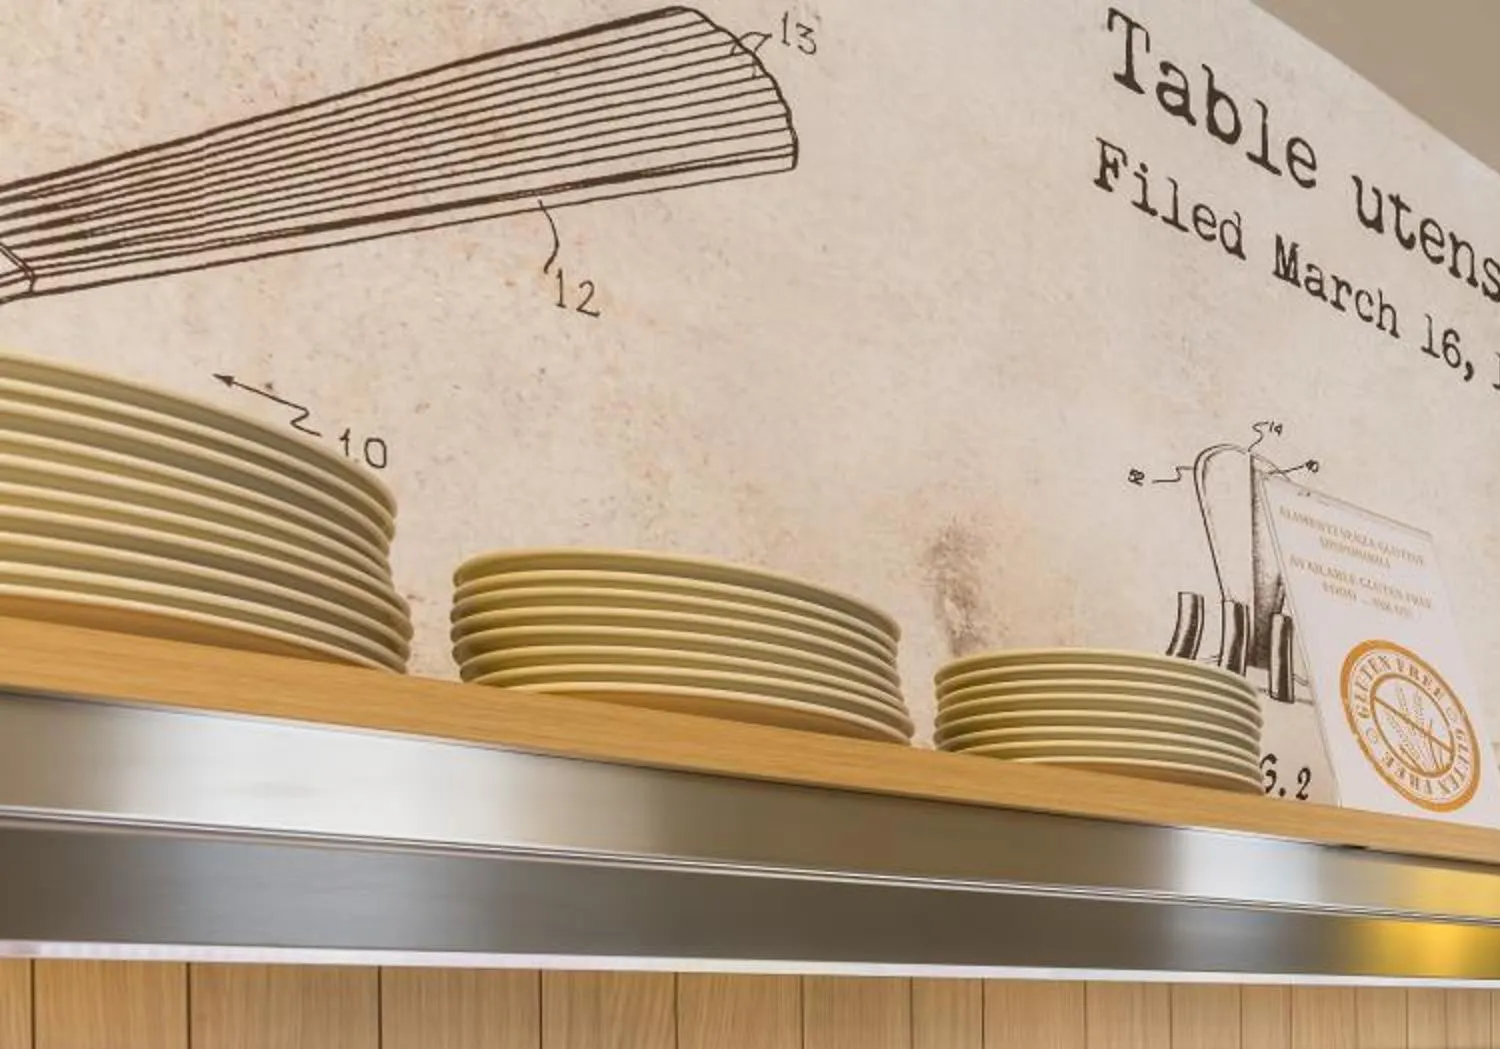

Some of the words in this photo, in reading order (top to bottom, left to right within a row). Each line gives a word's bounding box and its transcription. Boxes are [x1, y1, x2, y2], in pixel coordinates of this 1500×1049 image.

[781, 11, 817, 55] 13
[1106, 7, 1318, 190] Table
[1093, 137, 1247, 261] Filed
[1272, 233, 1401, 339] March
[1420, 313, 1475, 383] 16,
[556, 268, 601, 318] 12
[339, 428, 388, 470] 10
